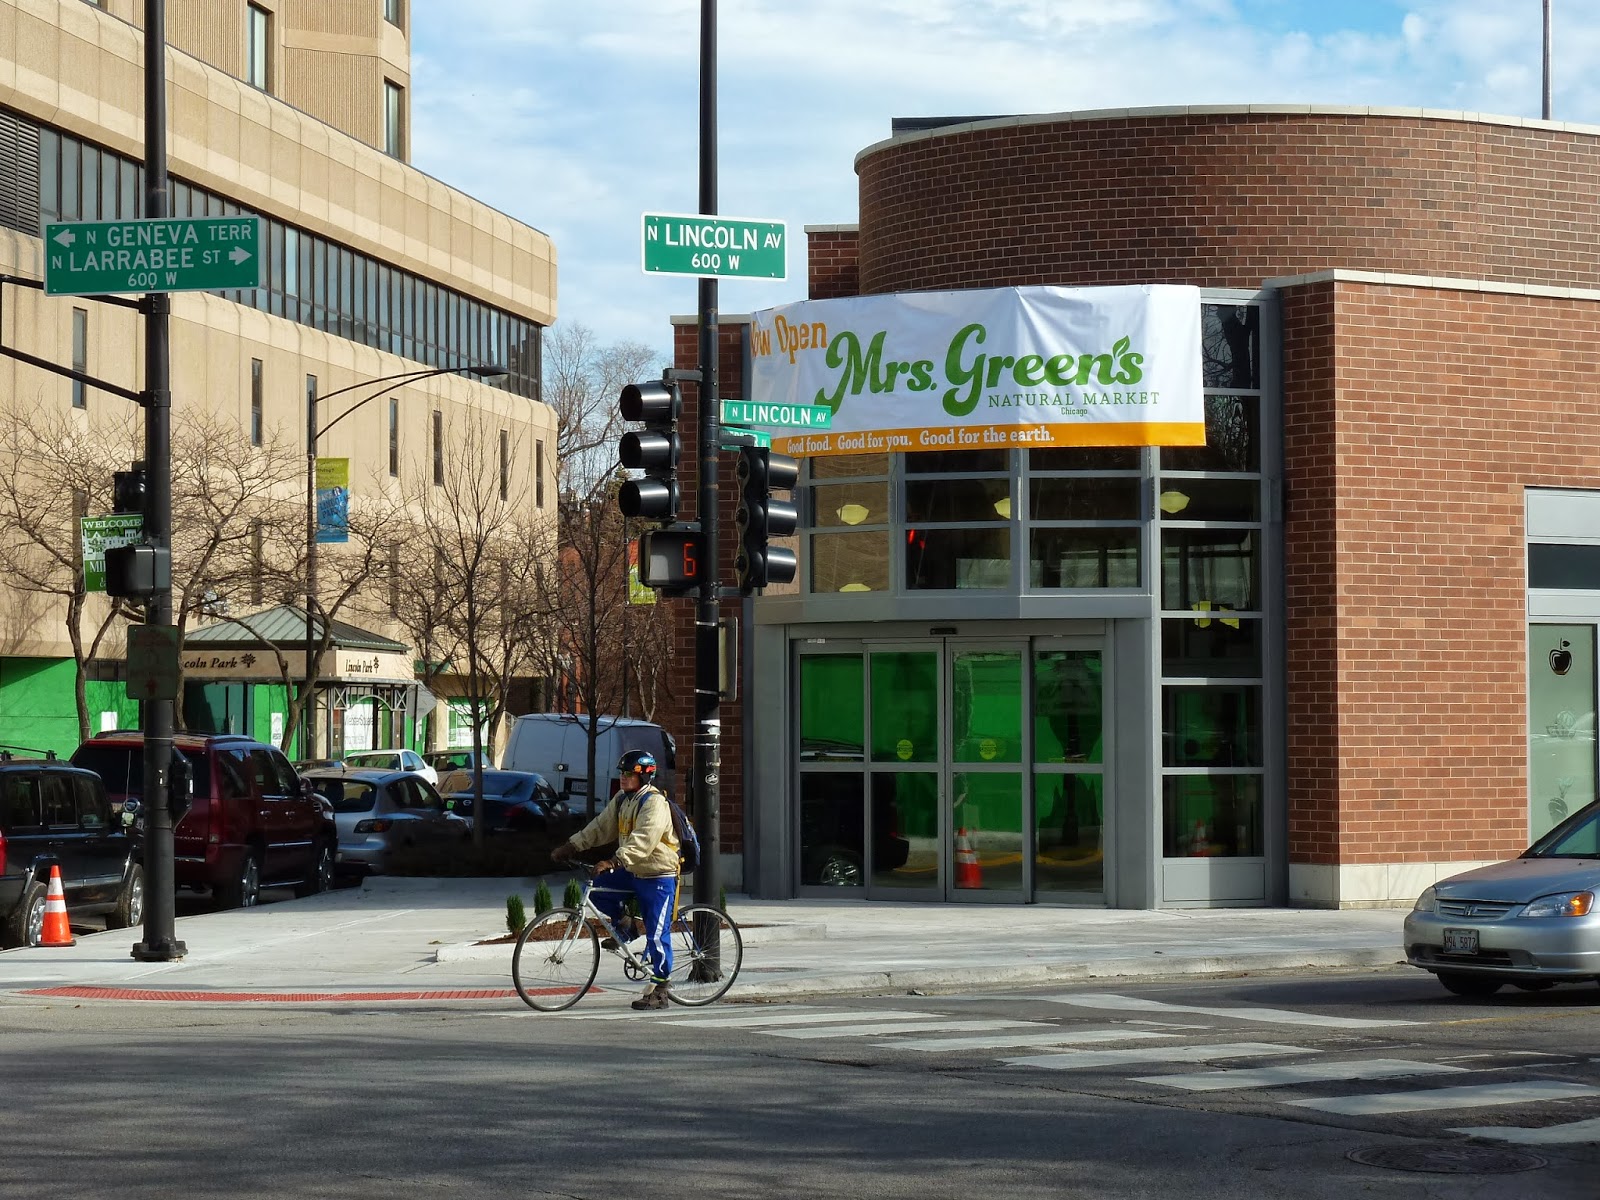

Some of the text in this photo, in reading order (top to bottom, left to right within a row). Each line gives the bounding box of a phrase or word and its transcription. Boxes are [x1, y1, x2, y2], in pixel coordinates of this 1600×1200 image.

[87, 224, 252, 247] N GENEVA TERR
[647, 223, 782, 250] N LINCOLN AV
[52, 248, 221, 272] N LARRABEE ST
[691, 253, 740, 270] 600 W
[127, 271, 177, 286] 600 W
[774, 314, 828, 365] Open
[814, 323, 1144, 417] Mrs. Green's
[988, 392, 1160, 408] NATURAL MARKET
[732, 404, 827, 425] N LINCOLN AV
[1060, 407, 1088, 417] Chicago
[787, 438, 804, 454] Good
[806, 436, 832, 452] food.
[837, 433, 865, 450] Good
[867, 432, 883, 448] for
[886, 435, 912, 451] you.
[920, 429, 955, 446] Good
[958, 428, 980, 444] for
[982, 426, 1007, 443] the
[1009, 425, 1055, 442] earth.
[84, 519, 142, 529] WELCOME
[684, 543, 696, 575] 6
[184, 657, 238, 668] coln Park
[362, 660, 373, 674] Park
